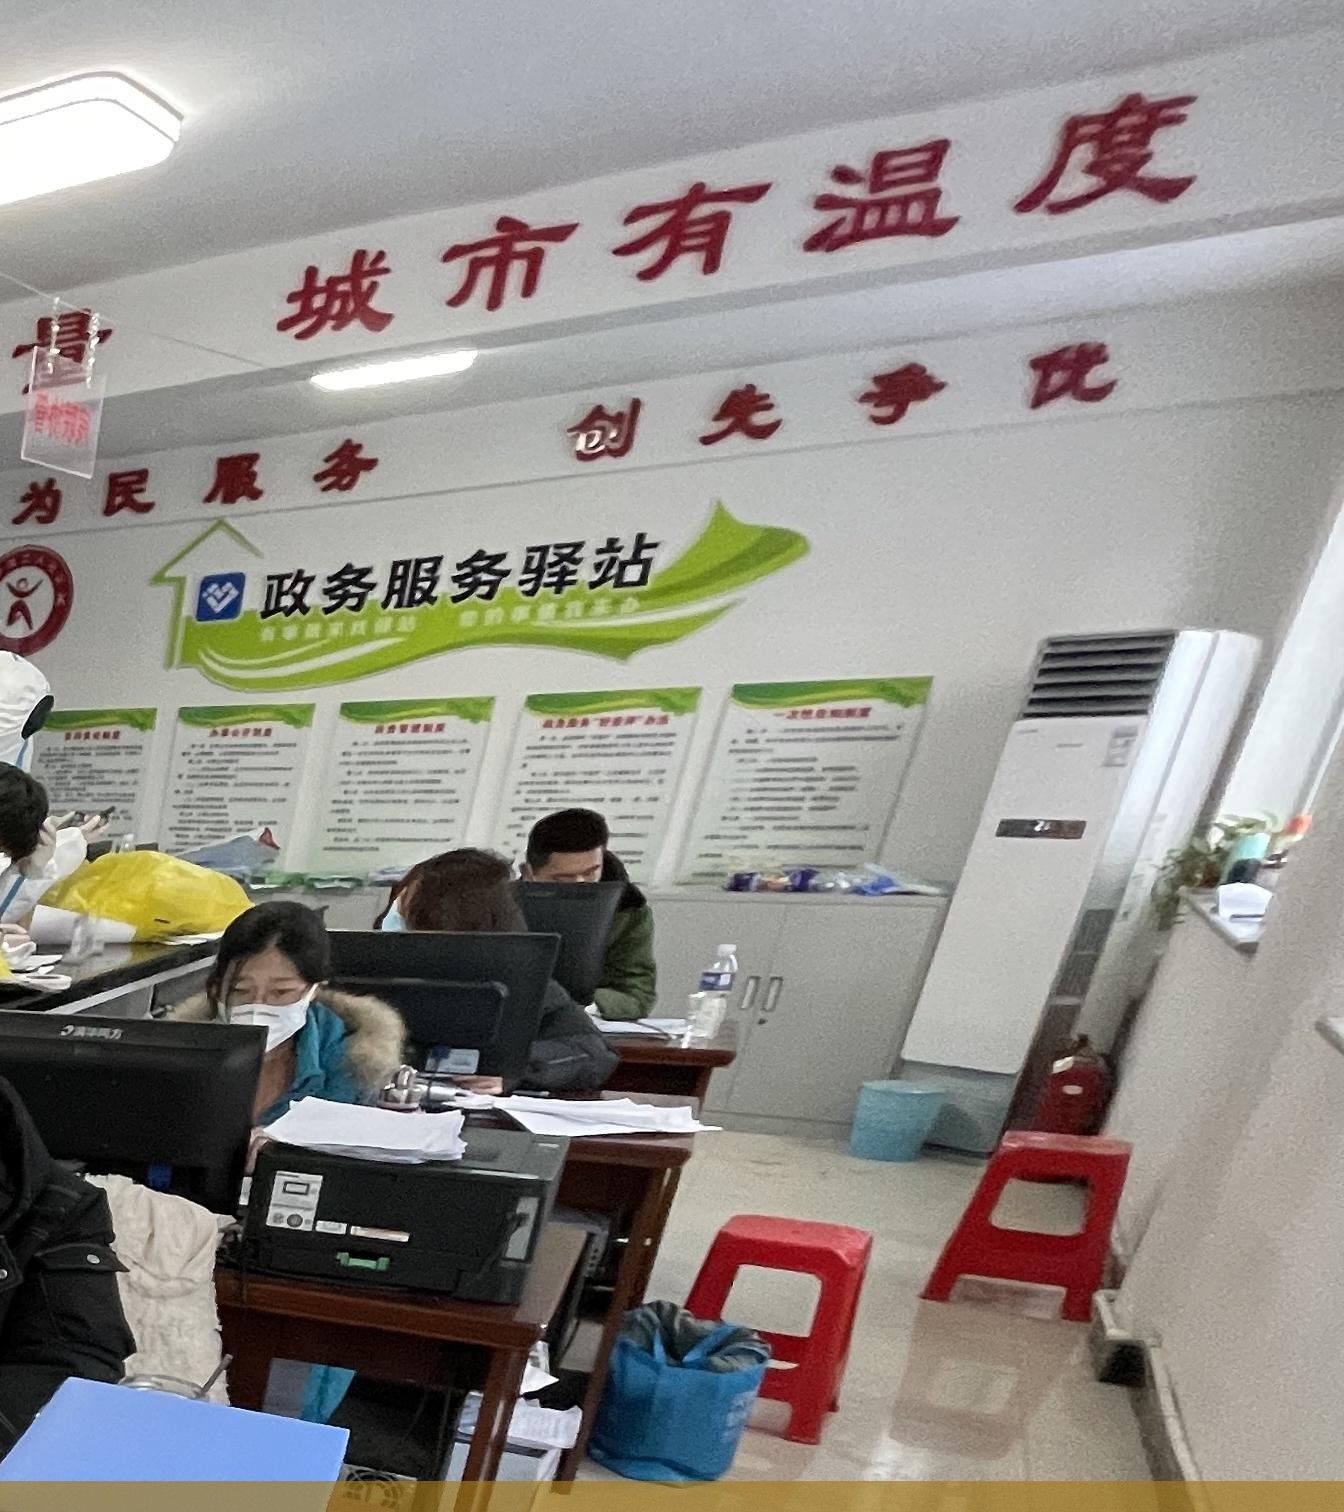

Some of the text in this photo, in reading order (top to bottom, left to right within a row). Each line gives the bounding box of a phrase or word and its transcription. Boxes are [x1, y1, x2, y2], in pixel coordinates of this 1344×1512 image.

[277, 93, 1196, 341] 城市有温度
[12, 342, 1118, 525] 为民服务 创先争优
[260, 532, 660, 621] 政务服务驿站
